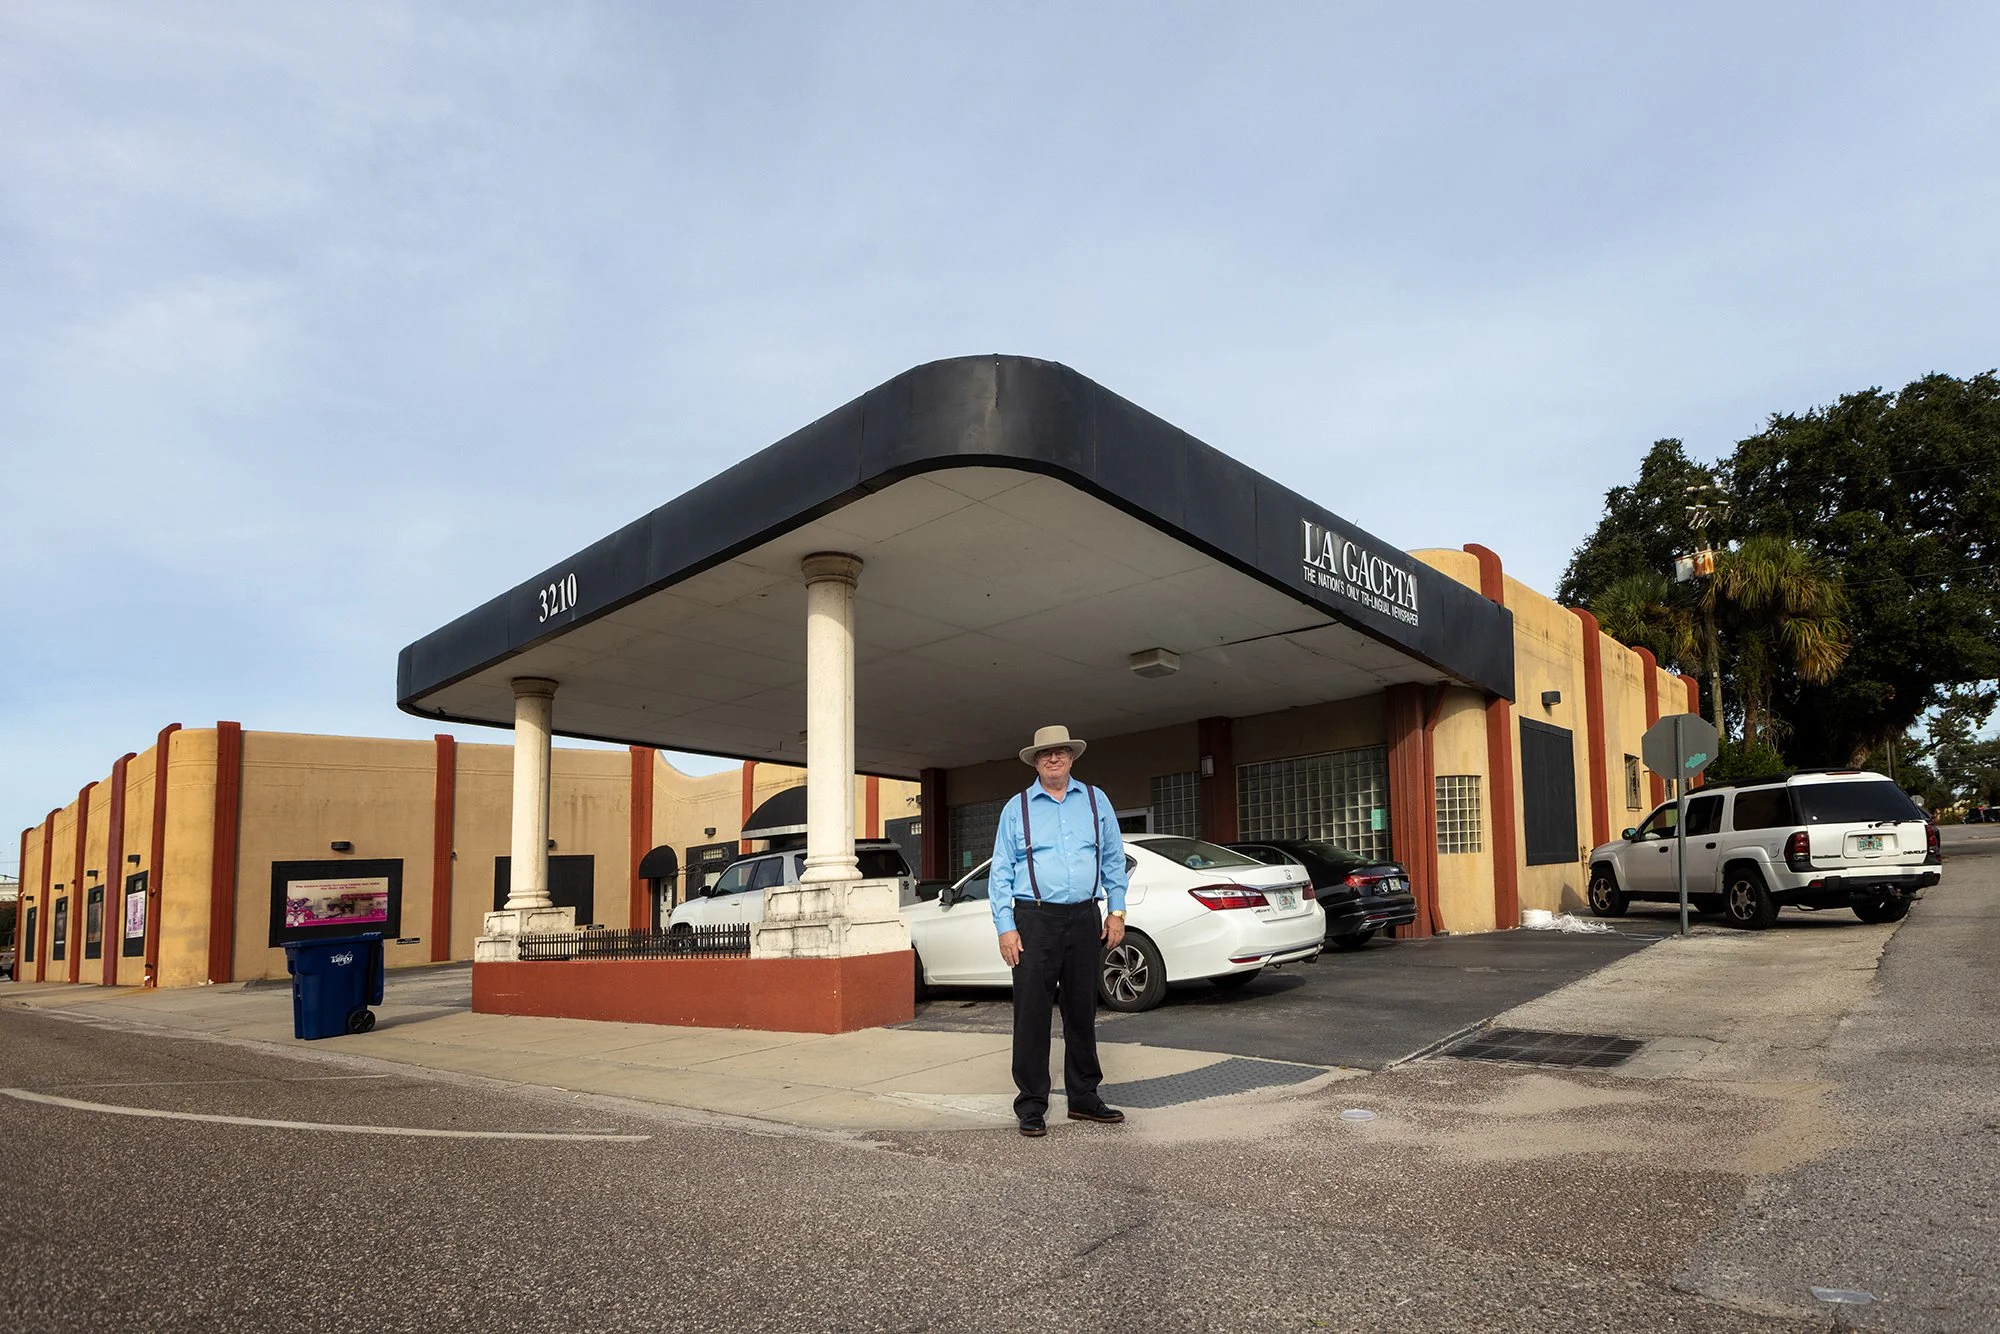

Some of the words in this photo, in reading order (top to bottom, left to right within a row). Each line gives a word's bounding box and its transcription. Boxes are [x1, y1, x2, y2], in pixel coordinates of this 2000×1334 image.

[1303, 520, 1338, 575] LA
[1342, 541, 1418, 612] GACETA
[1303, 566, 1317, 585] THE
[1318, 572, 1345, 595] NATION'S
[1346, 583, 1360, 602] ONLY
[1360, 591, 1391, 616] TRI-LINGUAL
[1391, 605, 1419, 627] NEWSPAPER
[538, 572, 577, 623] 3210
